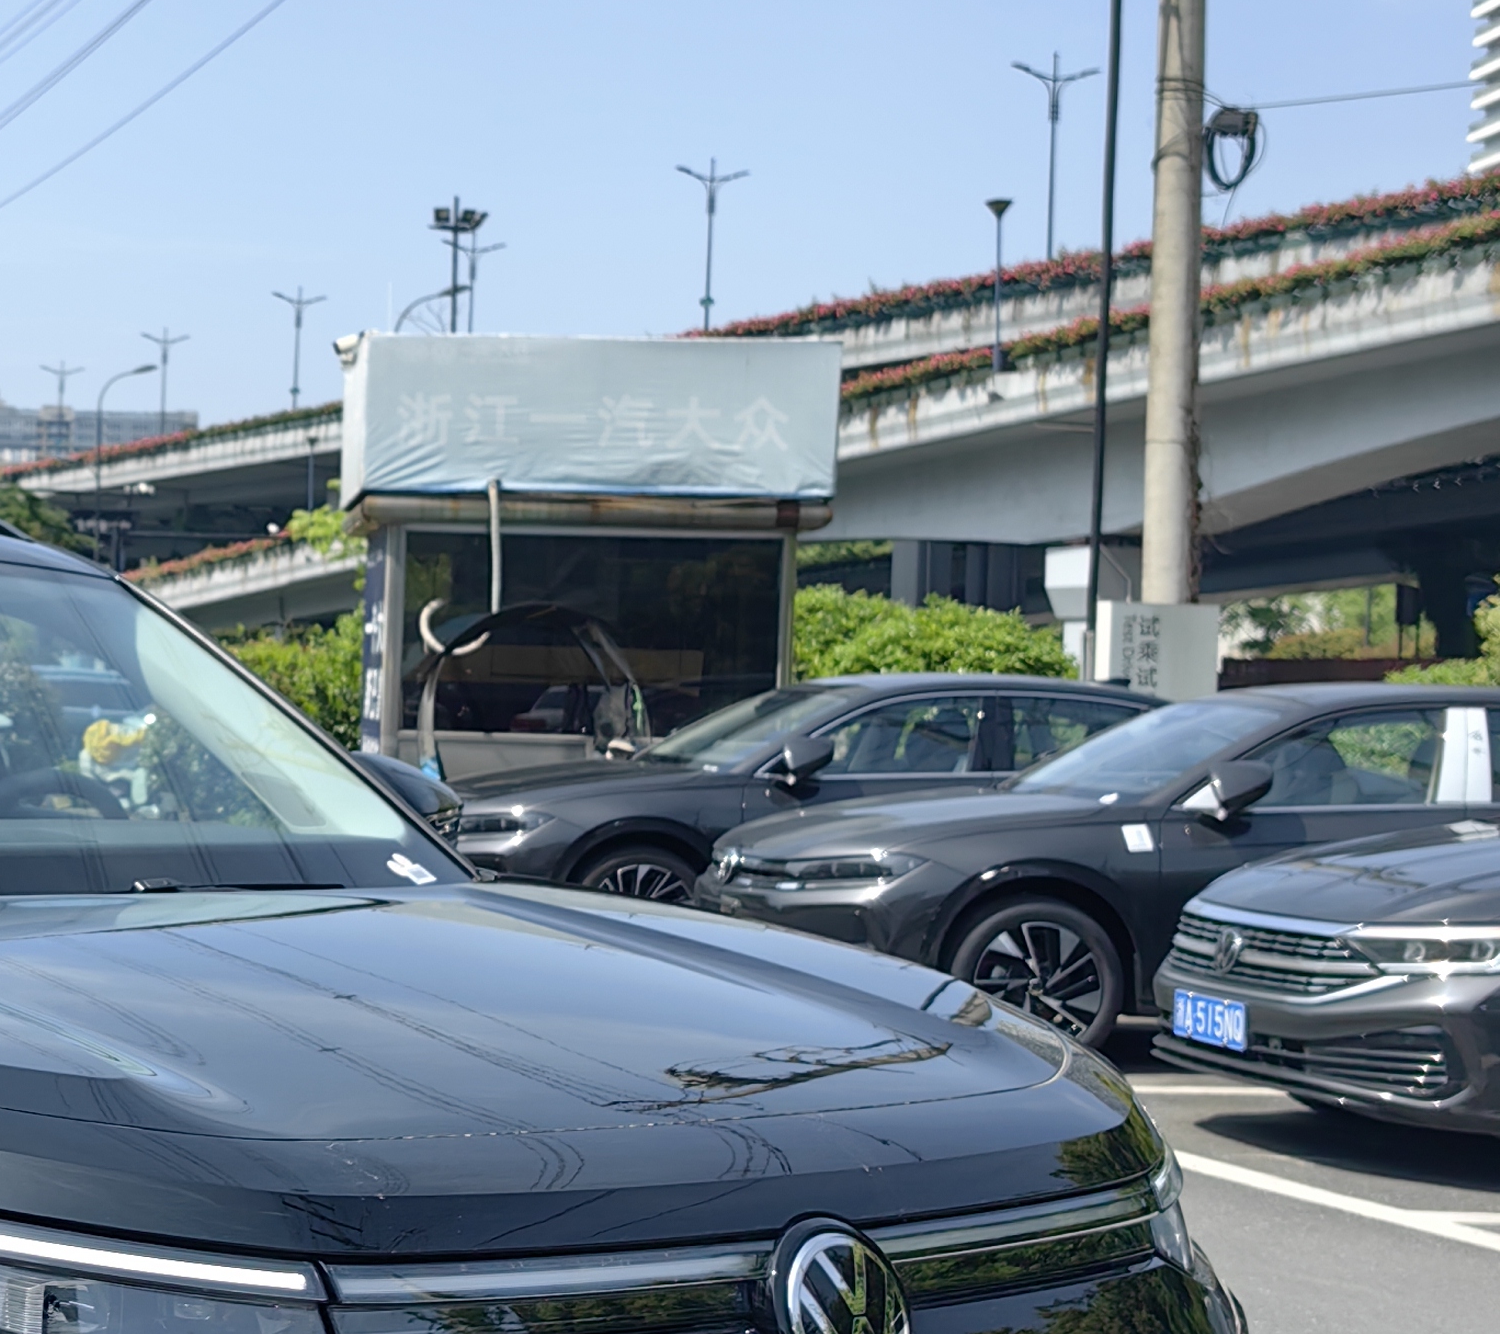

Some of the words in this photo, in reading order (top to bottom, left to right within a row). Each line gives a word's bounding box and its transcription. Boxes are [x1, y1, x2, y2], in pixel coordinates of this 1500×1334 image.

[397, 392, 789, 452] 浙江一汽大众
[1137, 614, 1160, 689] 试乘试
